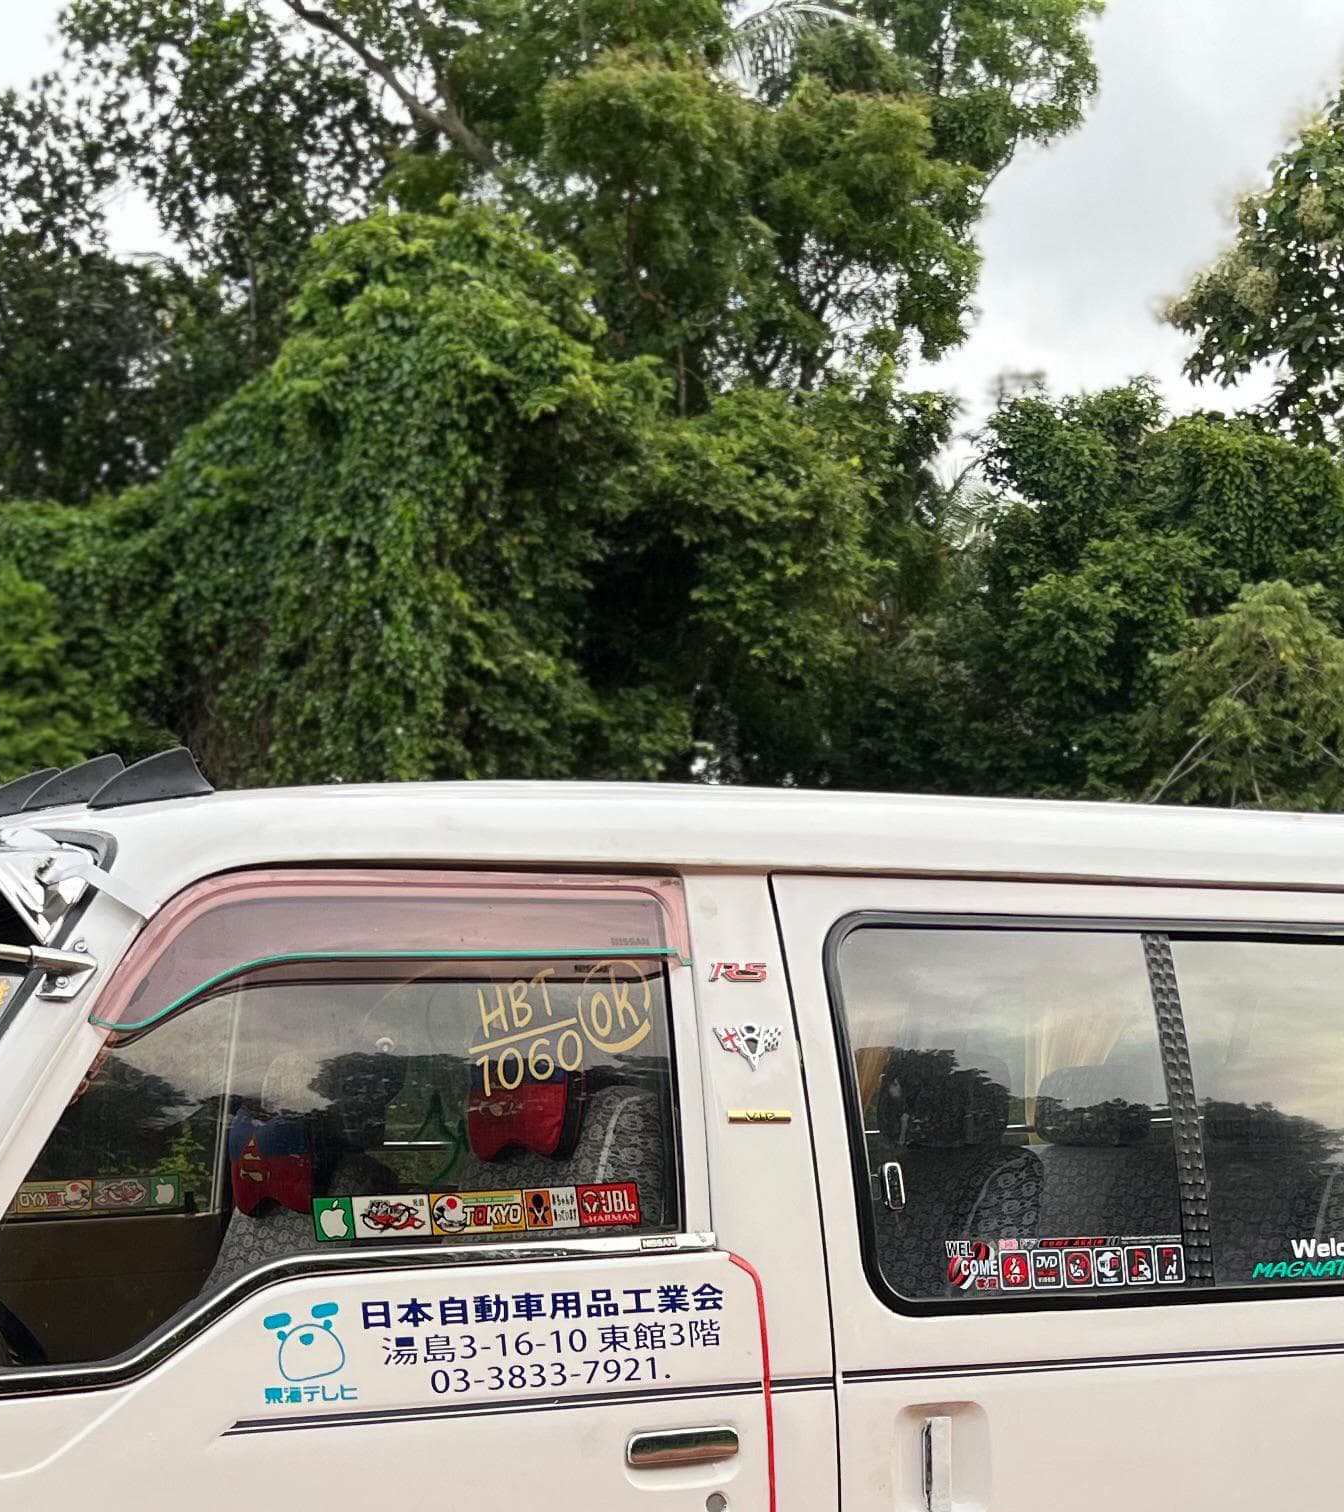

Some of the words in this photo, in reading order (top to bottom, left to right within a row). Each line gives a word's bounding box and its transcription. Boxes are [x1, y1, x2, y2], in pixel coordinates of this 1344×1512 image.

[477, 968, 555, 1038] HBT
[476, 1030, 583, 1097] 1060
[463, 1204, 522, 1225] TOKYO
[602, 1190, 636, 1213] JBL
[961, 1259, 998, 1275] COME
[361, 1283, 723, 1329] 日本自動車用品工業会
